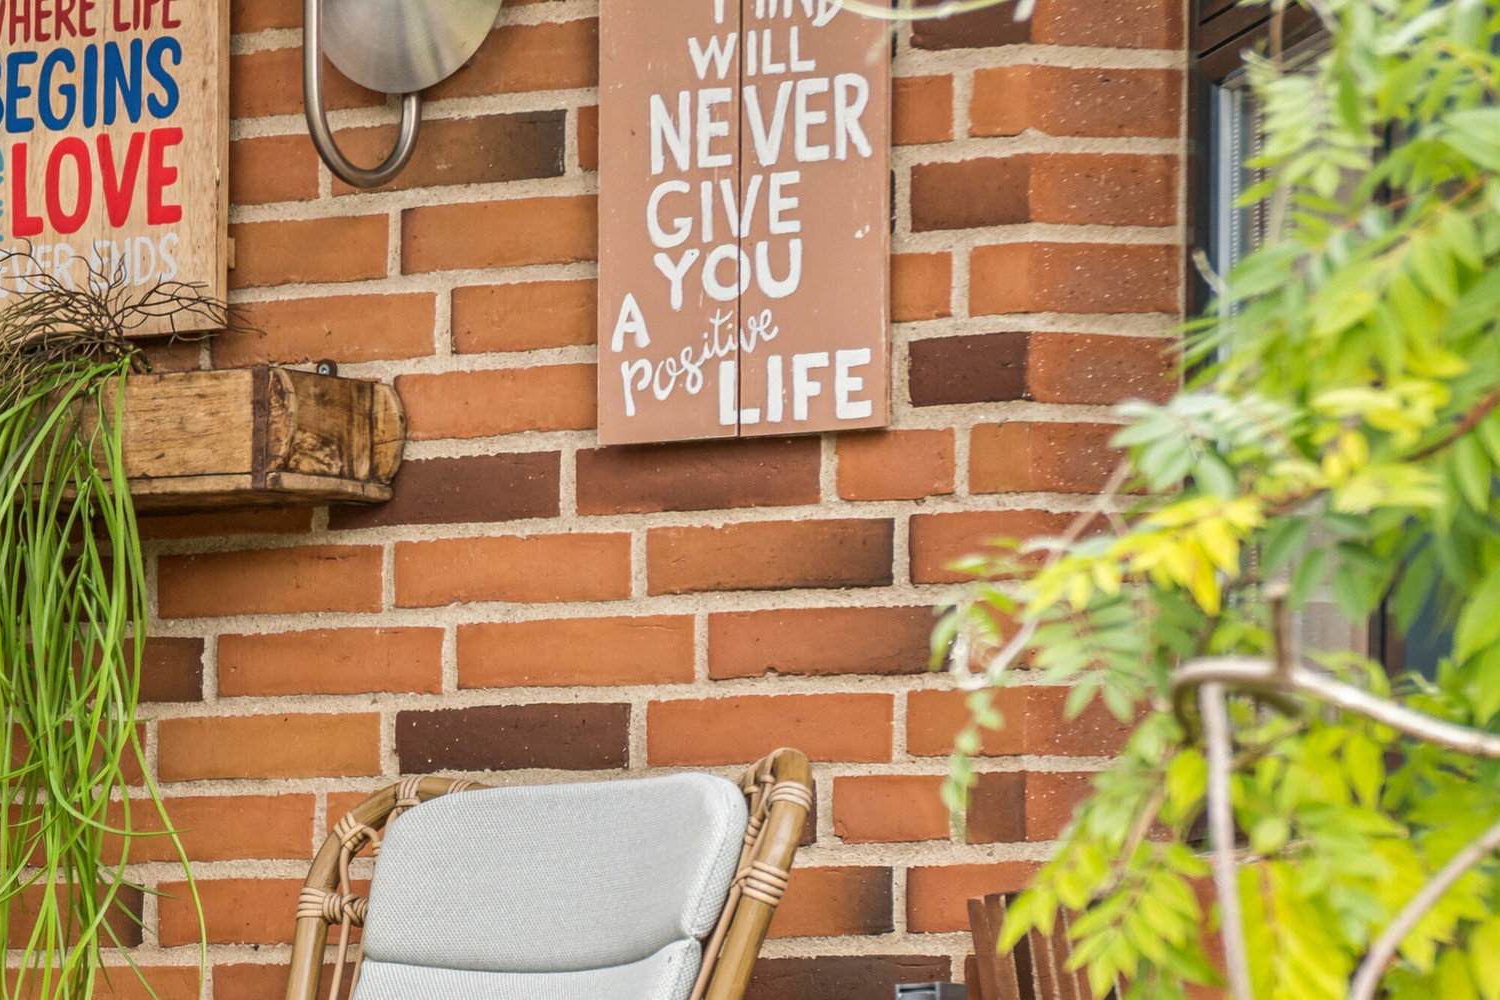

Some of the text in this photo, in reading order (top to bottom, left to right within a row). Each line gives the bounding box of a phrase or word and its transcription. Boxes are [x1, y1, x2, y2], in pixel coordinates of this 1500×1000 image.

[113, 0, 182, 32] LIFE
[688, 26, 816, 79] WILL
[650, 73, 873, 175] NEVER
[12, 127, 183, 237] LOVE
[646, 171, 801, 249] GIVE
[89, 232, 180, 292] ENDS
[653, 238, 802, 310] YOU
[611, 293, 650, 352] A
[620, 308, 779, 417] positive
[719, 348, 873, 425] LIFE
